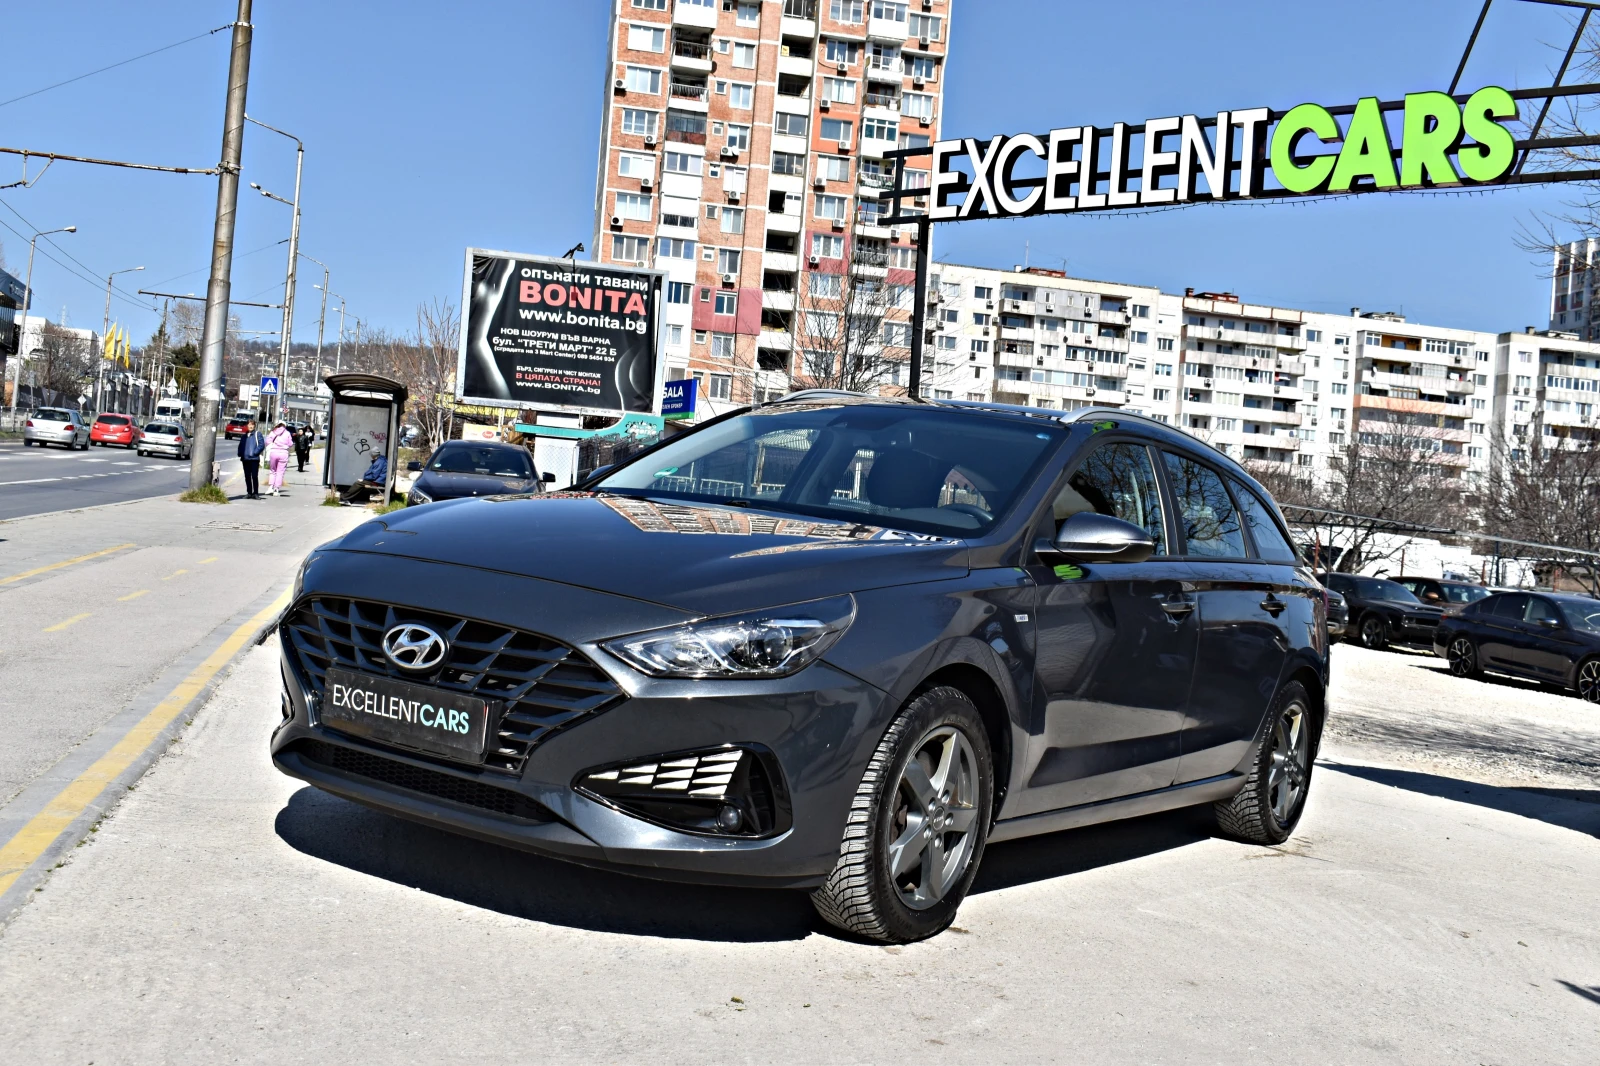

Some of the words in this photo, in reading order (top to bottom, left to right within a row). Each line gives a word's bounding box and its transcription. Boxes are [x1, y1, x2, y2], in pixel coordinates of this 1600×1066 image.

[521, 268, 590, 284] опънати
[594, 275, 648, 291] тавани
[519, 280, 647, 315] BONITA
[519, 309, 647, 334] www.bonita.bg
[500, 327, 519, 335] НОВ
[521, 329, 558, 340] ШОУРУМ
[560, 333, 580, 342] ВЪВ
[581, 335, 611, 345] ВАРНА
[492, 336, 515, 347] бул.
[595, 346, 607, 355] 22
[609, 348, 617, 356] Б
[554, 351, 576, 359] Center)
[516, 365, 533, 373] БЪРЗ,
[515, 381, 601, 395] www.BONITA.bg
[524, 373, 560, 382] ЦЯЛАТА
[562, 376, 601, 386] СТРАНА!
